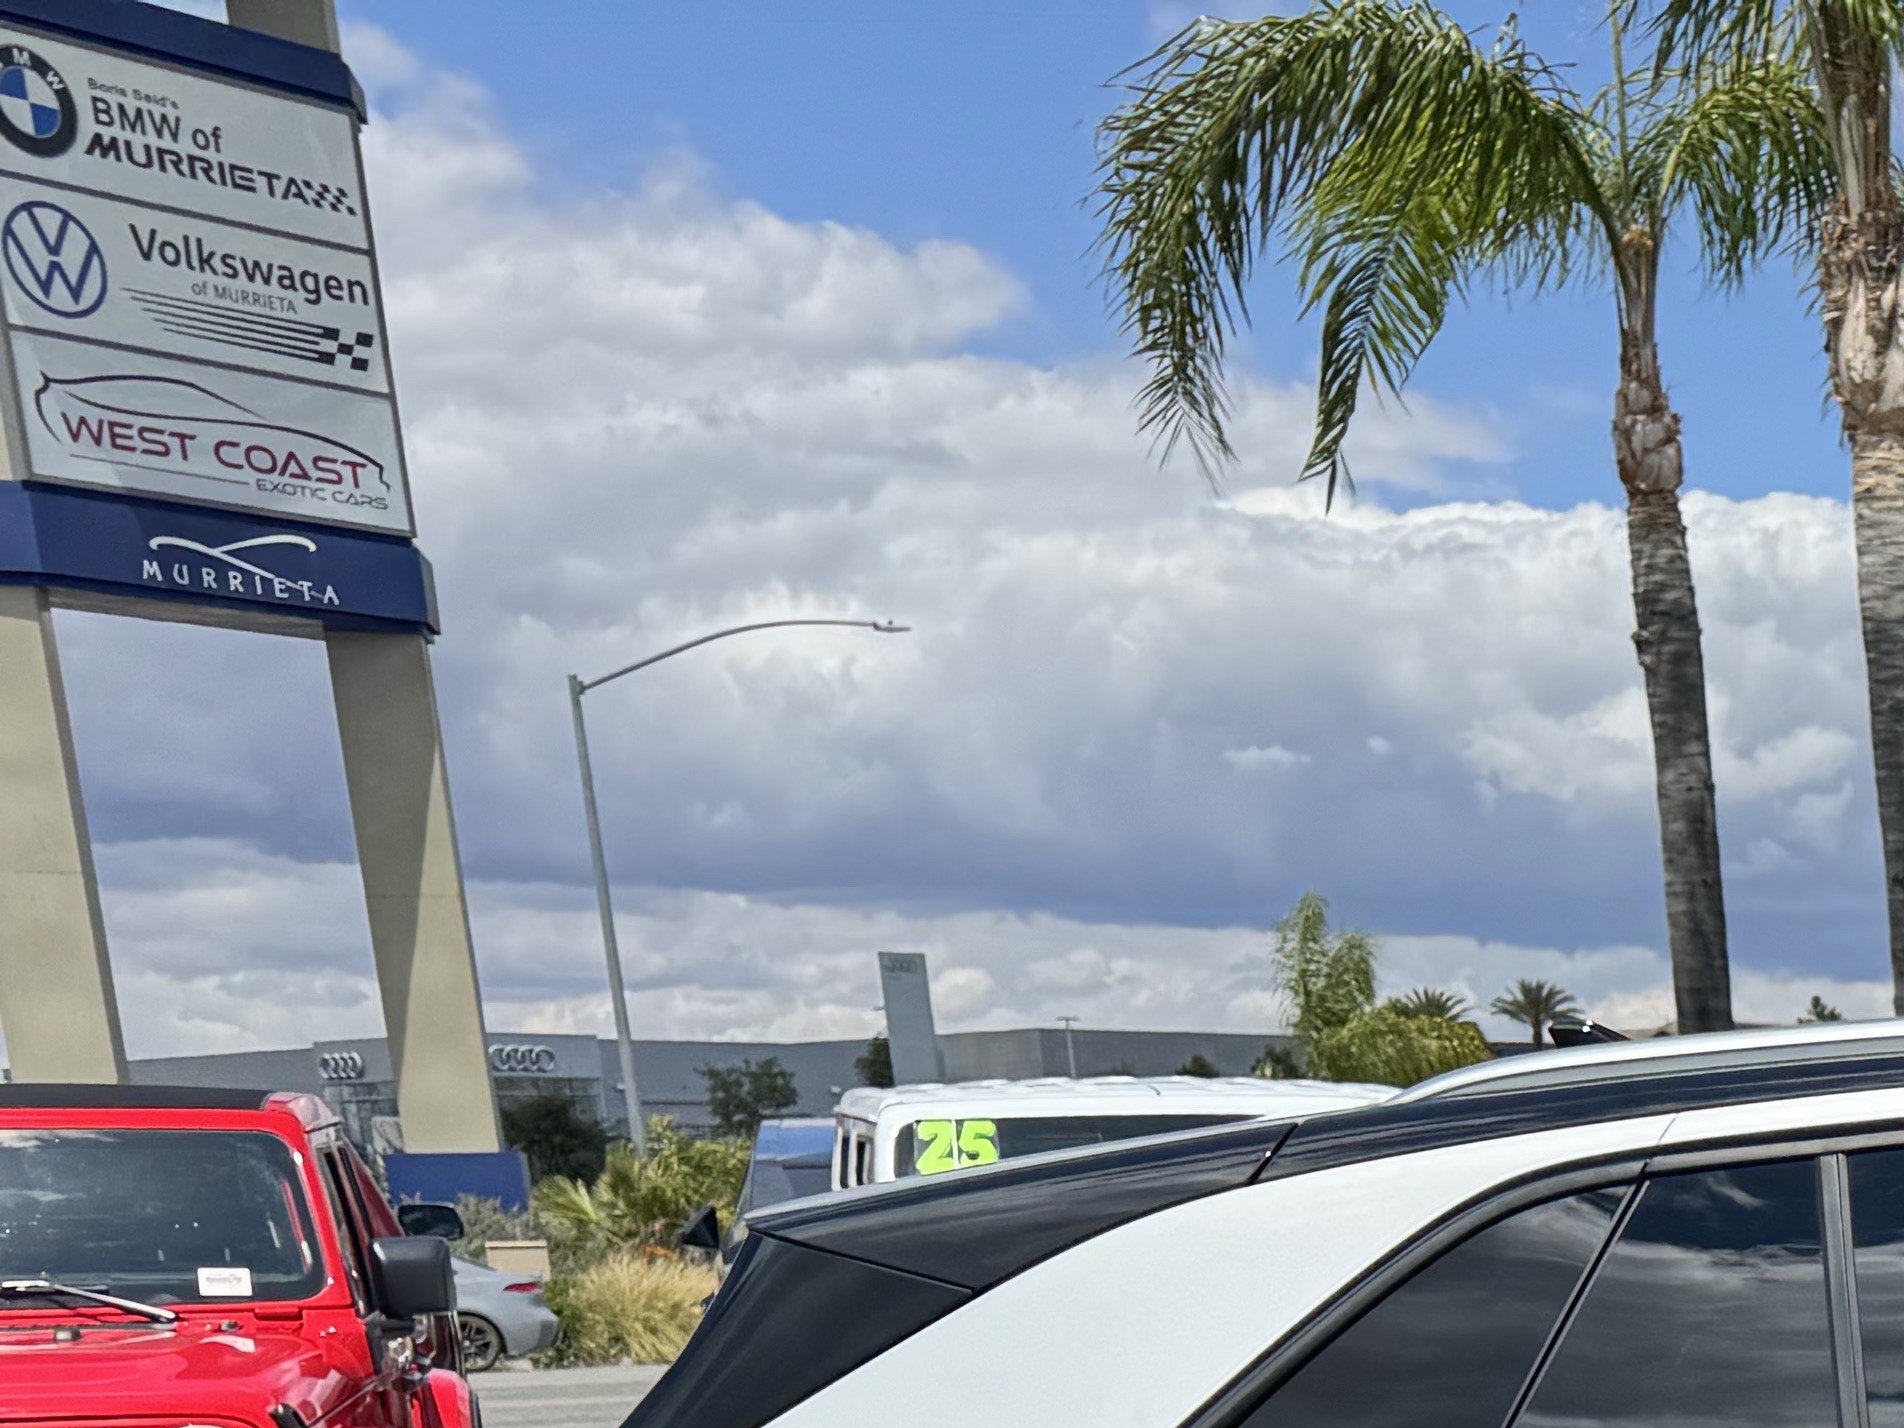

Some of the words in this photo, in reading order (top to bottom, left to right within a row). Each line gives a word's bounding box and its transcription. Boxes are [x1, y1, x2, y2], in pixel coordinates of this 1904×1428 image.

[91, 95, 181, 143] BMW
[191, 125, 222, 153] of
[84, 132, 310, 206] MURRIETA
[128, 223, 370, 306] Volkswagen
[190, 281, 208, 297] of
[213, 284, 298, 315] MURRIETA
[60, 411, 197, 462] WEST
[213, 440, 369, 490] COAST
[256, 478, 328, 501] EXOTIC
[331, 490, 390, 511] CARS
[142, 559, 340, 606] MURRIETA
[915, 1120, 998, 1176] 25
